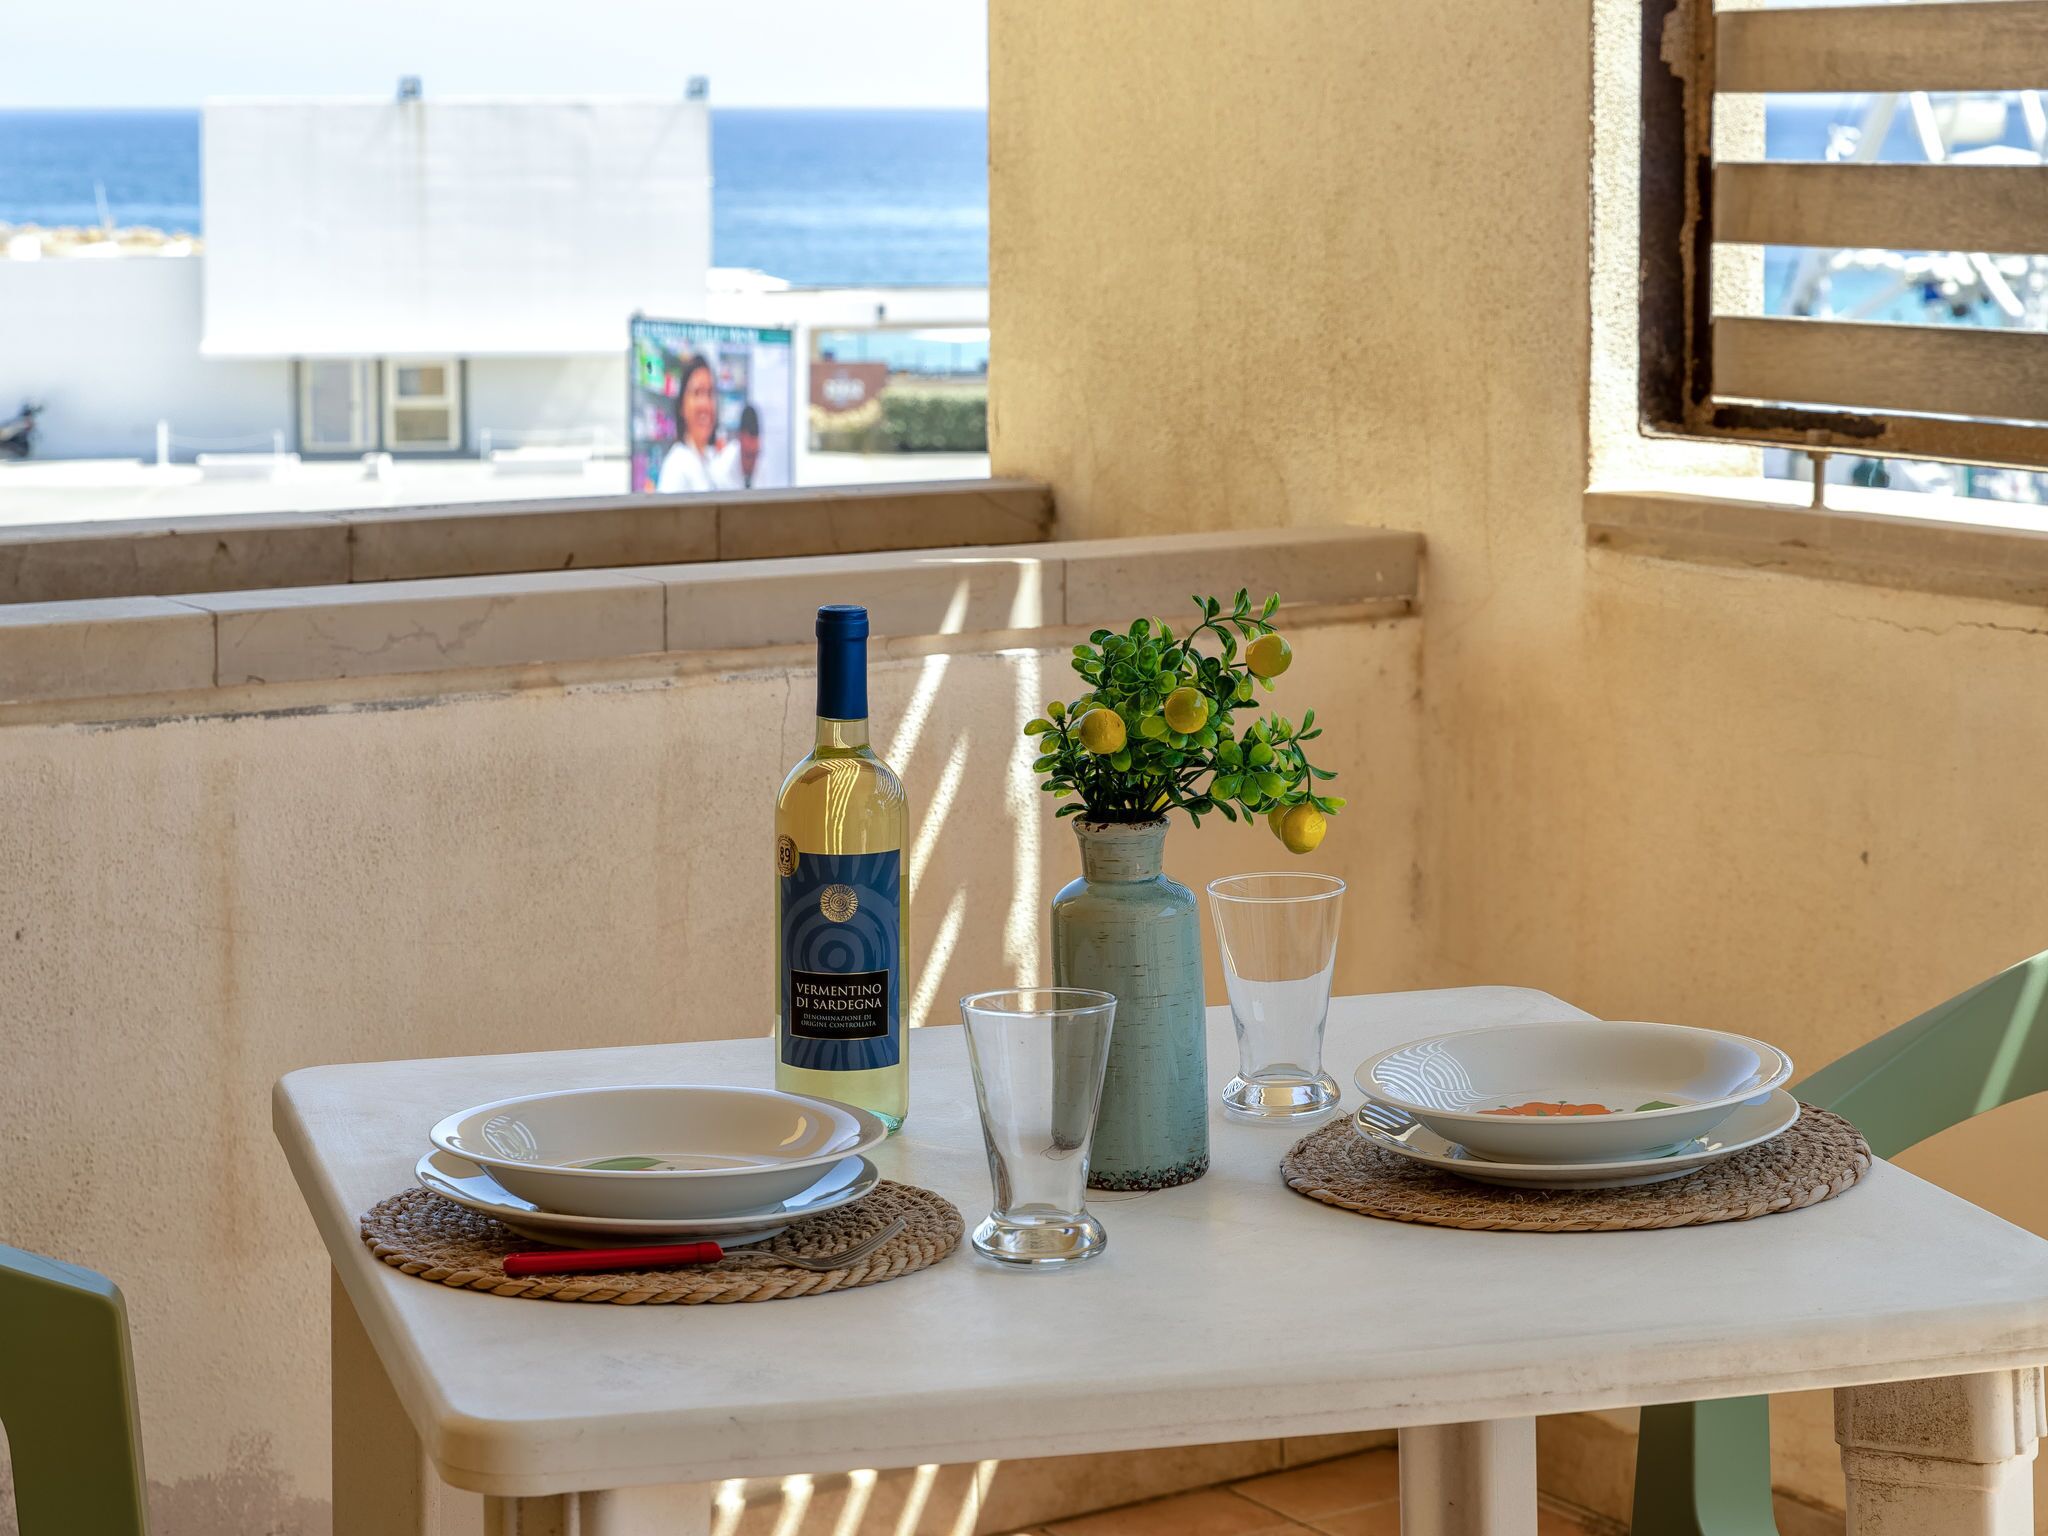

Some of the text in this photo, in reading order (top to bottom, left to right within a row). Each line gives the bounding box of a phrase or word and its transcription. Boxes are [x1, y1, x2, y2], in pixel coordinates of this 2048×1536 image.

[796, 982, 882, 996] VERMENTINO
[796, 997, 882, 1010] DI SARDEGNA
[803, 1013, 861, 1021] DENOMINAZIONE
[801, 1020, 876, 1029] ORIGINE CONTROLLATA
